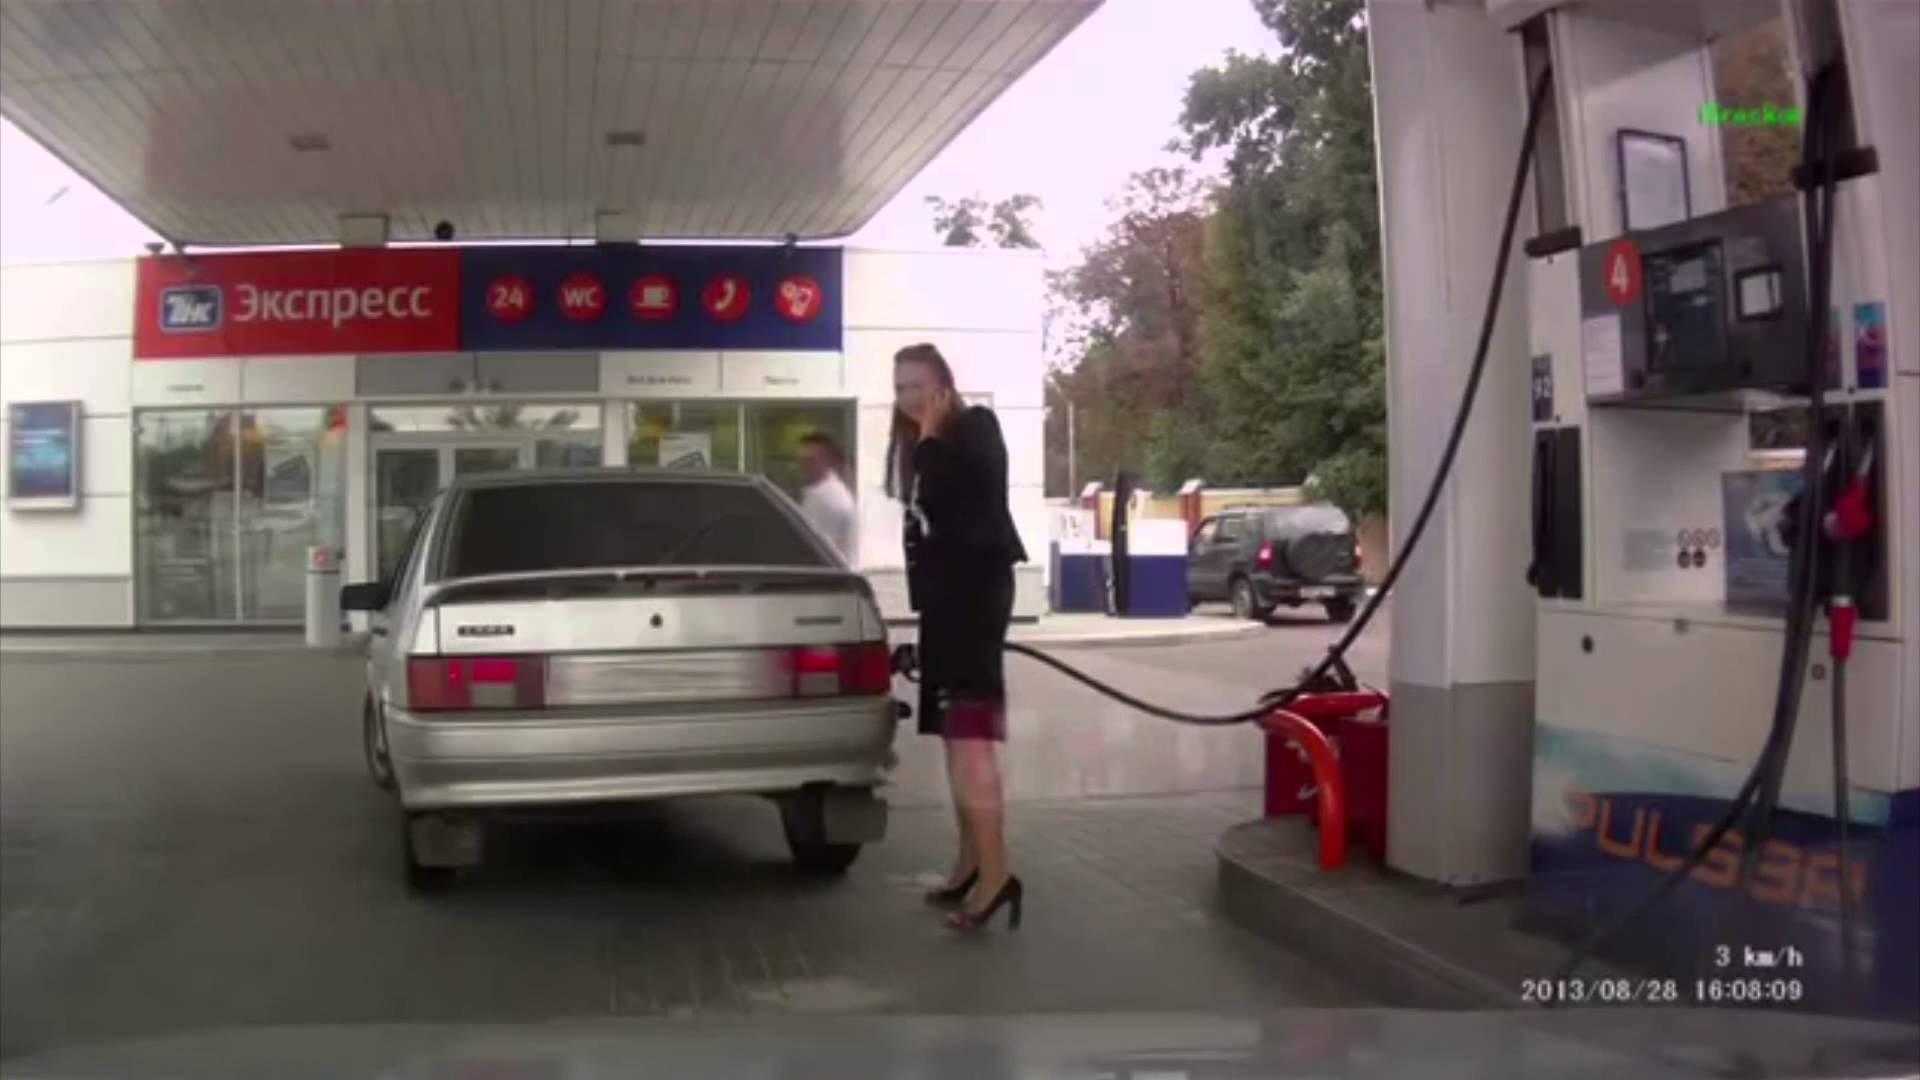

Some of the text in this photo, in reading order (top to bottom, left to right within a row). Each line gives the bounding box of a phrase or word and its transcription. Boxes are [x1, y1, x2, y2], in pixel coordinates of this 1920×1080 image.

[1610, 253, 1630, 295] 4
[233, 284, 432, 328] Экспресс
[495, 286, 601, 309] 24 WC
